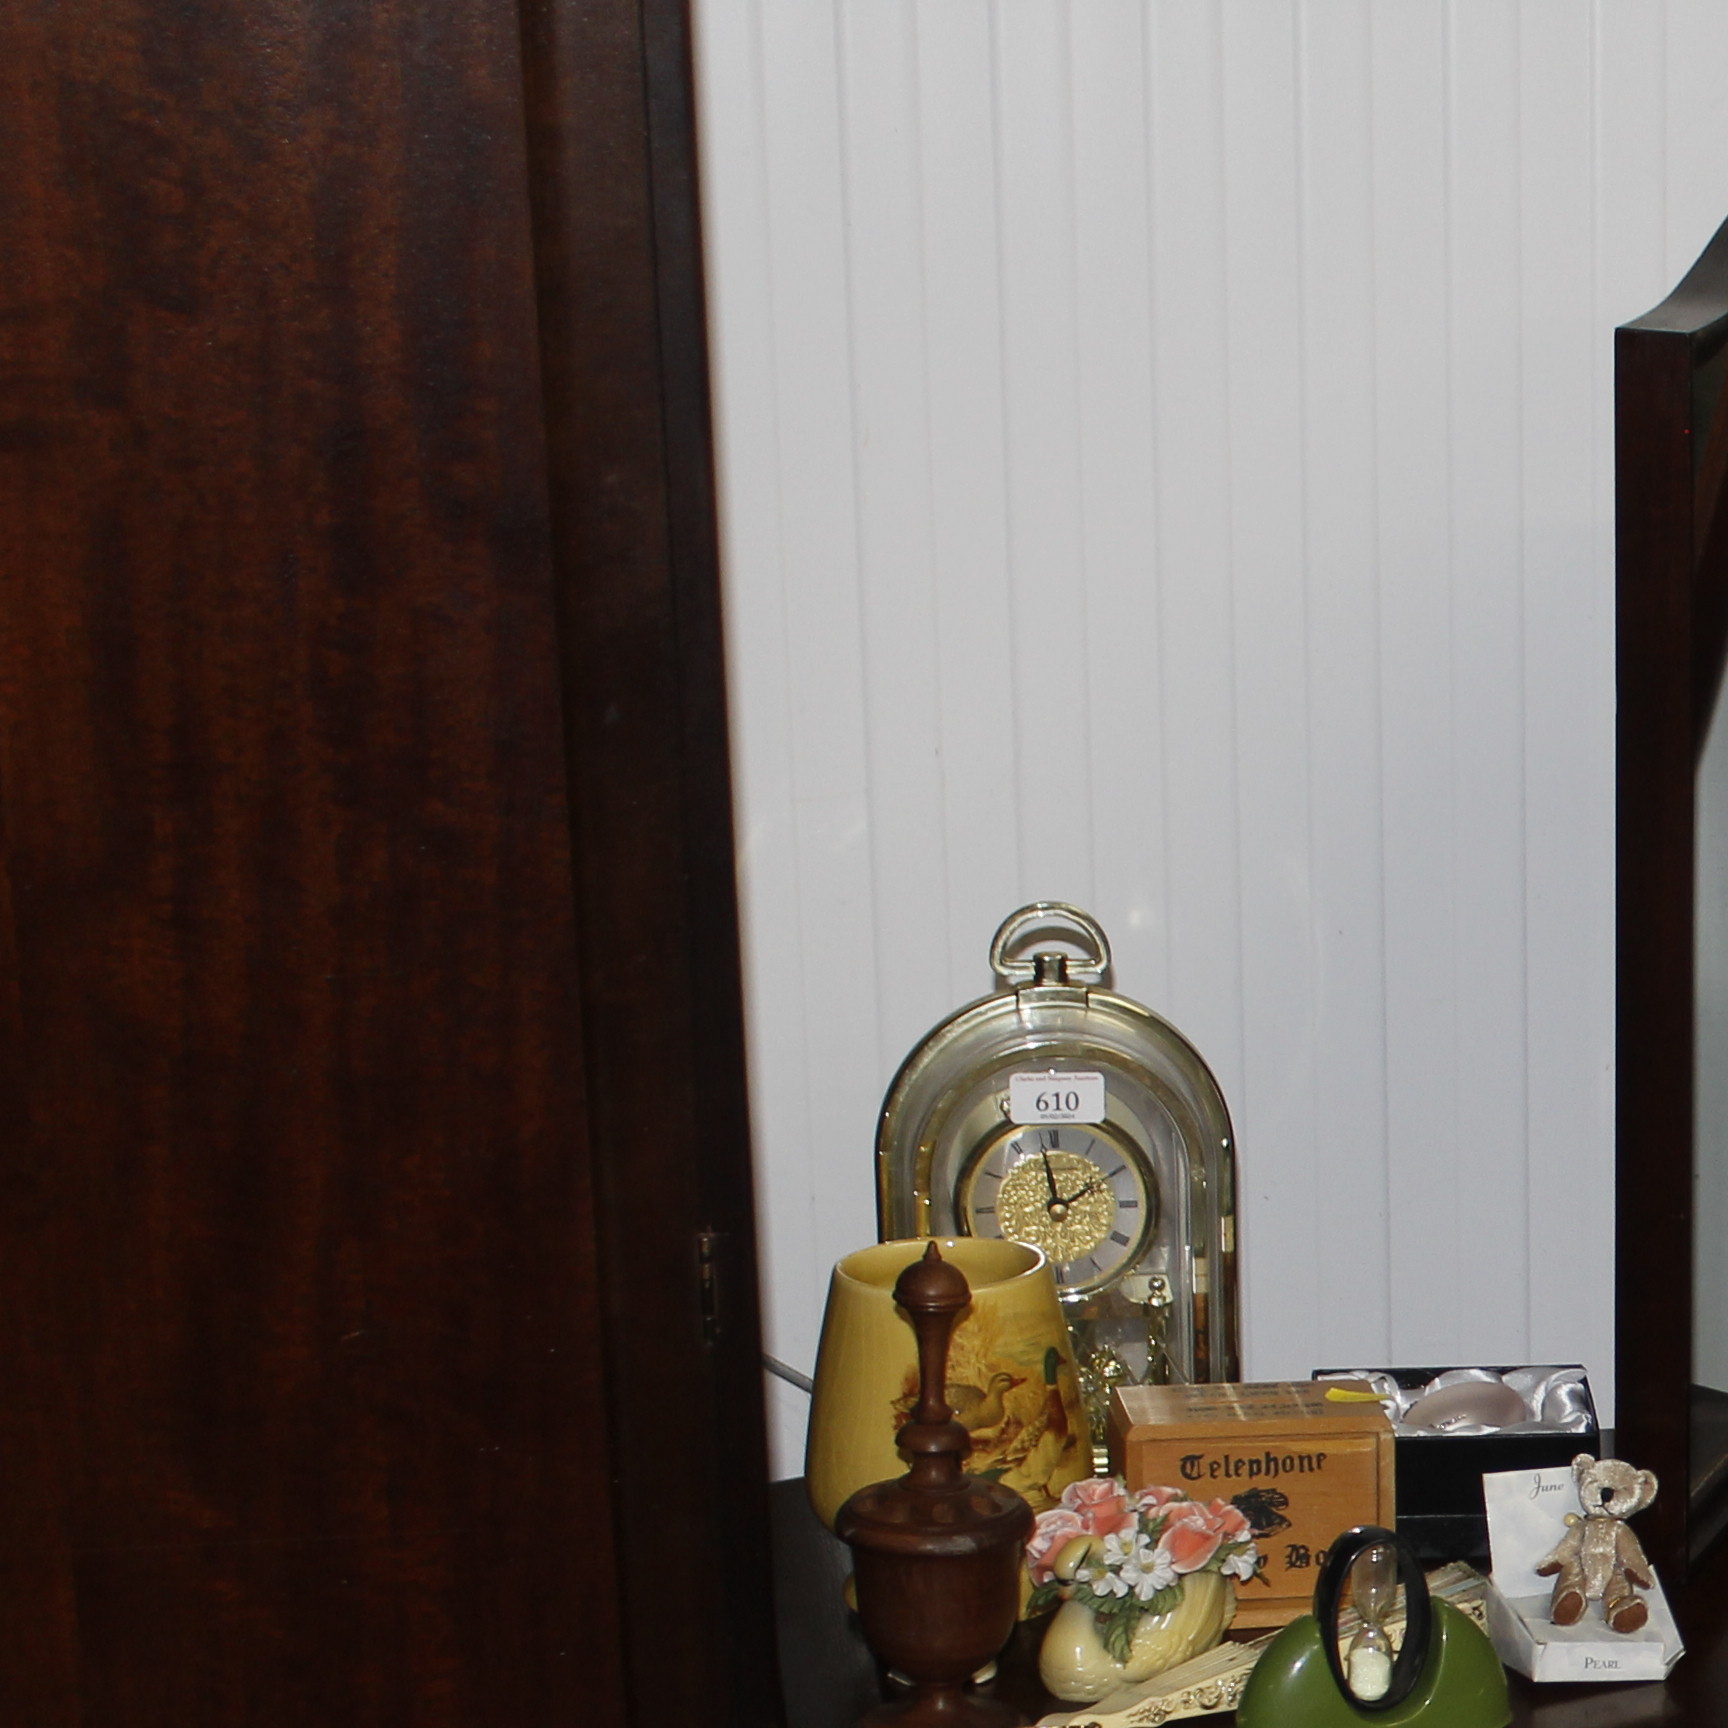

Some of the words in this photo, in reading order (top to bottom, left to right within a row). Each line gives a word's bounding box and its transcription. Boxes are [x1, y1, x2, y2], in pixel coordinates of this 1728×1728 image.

[1035, 1091, 1080, 1111] 610
[1179, 1451, 1327, 1480] Telephone
[1530, 1474, 1565, 1500] June
[1285, 1544, 1328, 1570] Bo
[1584, 1657, 1621, 1670] PEARL
